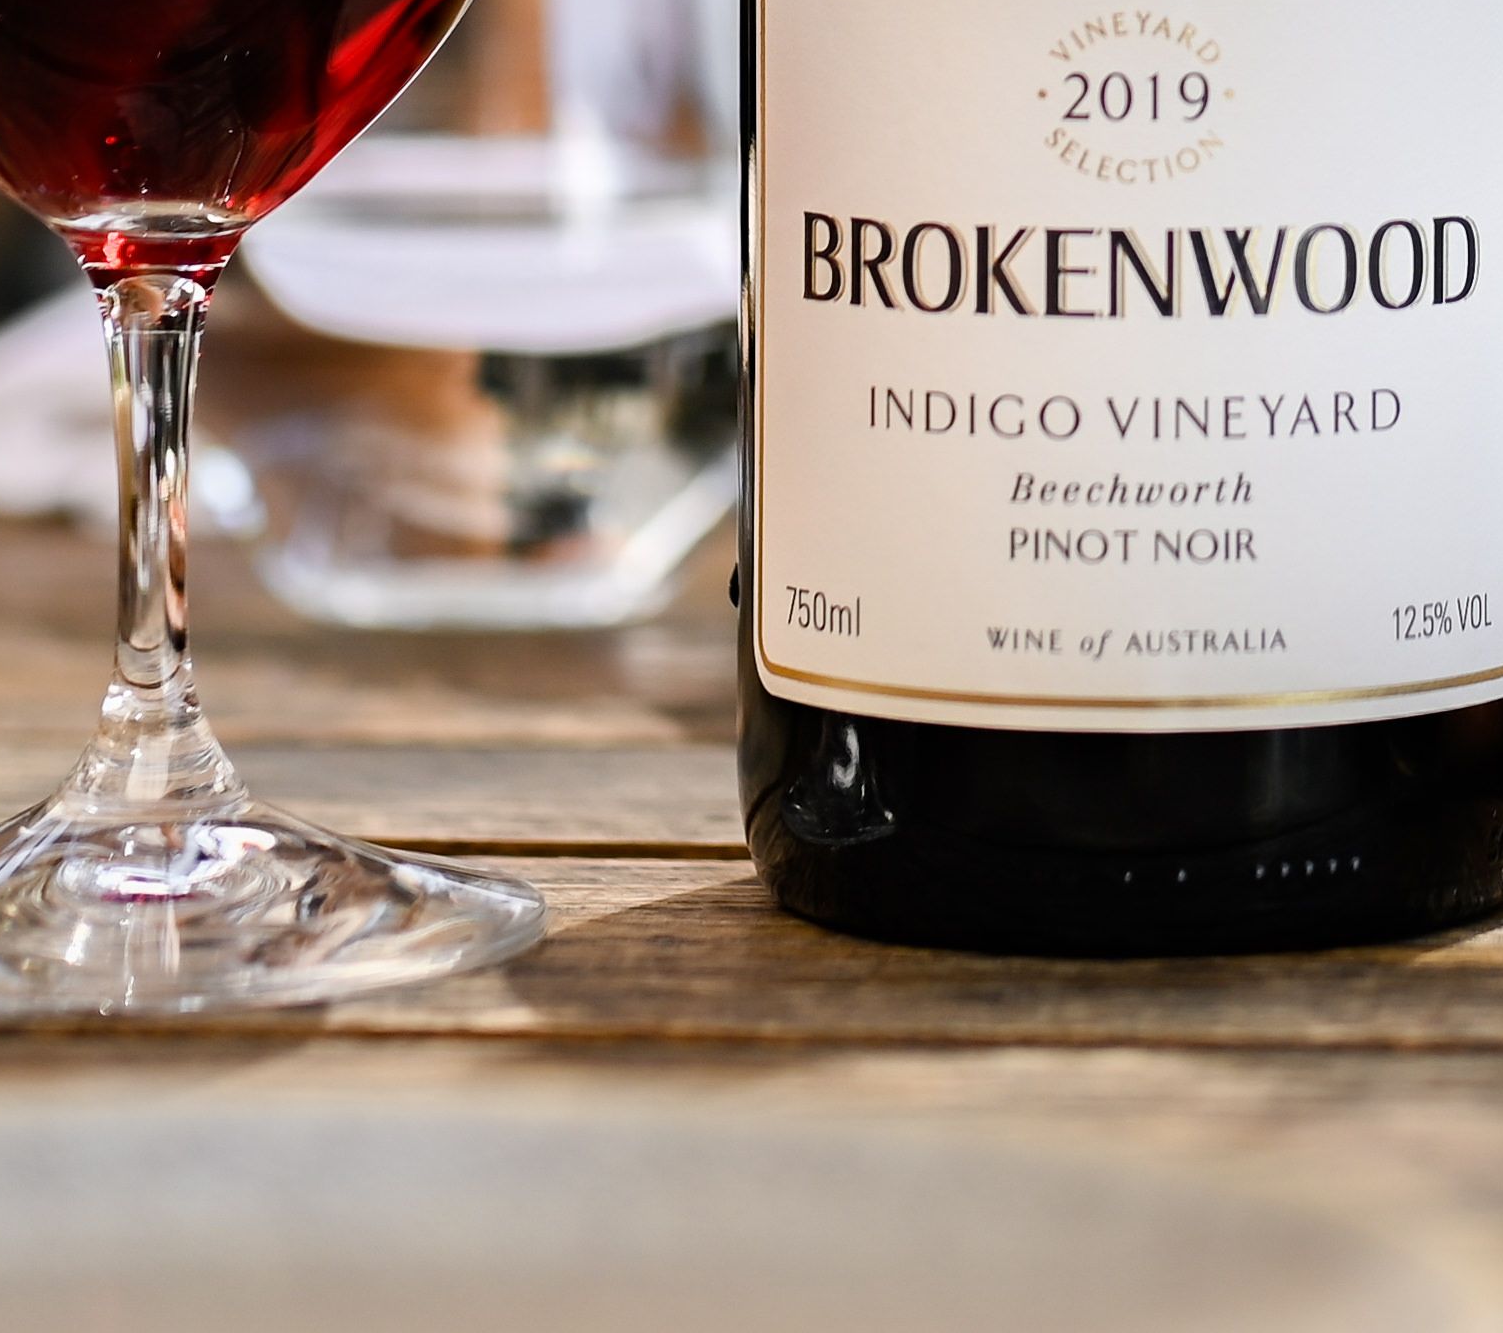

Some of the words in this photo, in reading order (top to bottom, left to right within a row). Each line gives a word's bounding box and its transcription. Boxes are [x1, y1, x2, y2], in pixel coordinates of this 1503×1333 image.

[1048, 10, 1221, 63] VINEYARD
[1061, 70, 1211, 123] 2019
[1045, 127, 1225, 184] SELECTION
[801, 210, 1482, 321] BROKENWOOD
[869, 384, 1083, 442] INDIGO
[1105, 387, 1403, 442] VINEYARD
[1009, 470, 1254, 507] Beechworth
[1008, 526, 1139, 565] PINOT
[1153, 527, 1258, 565] NOIR
[785, 584, 862, 638] 750ml
[1391, 599, 1453, 642] 12.5%
[1456, 592, 1494, 633] VOL
[986, 626, 1064, 655] WINE
[1079, 628, 1114, 662] of
[1124, 627, 1288, 656] AUSTRALIA
